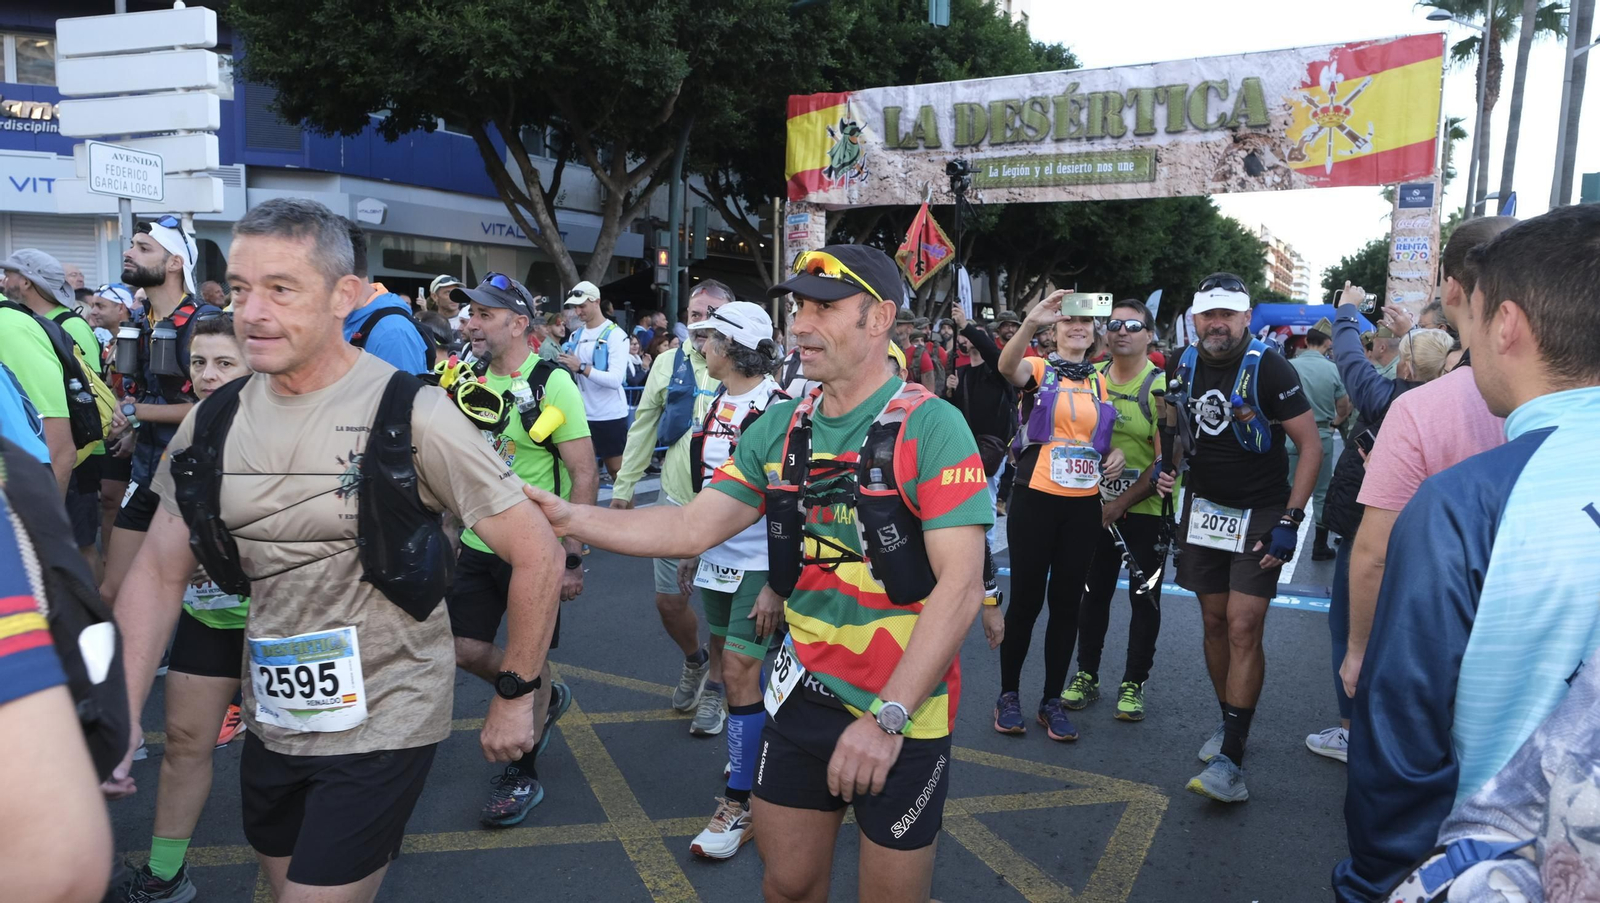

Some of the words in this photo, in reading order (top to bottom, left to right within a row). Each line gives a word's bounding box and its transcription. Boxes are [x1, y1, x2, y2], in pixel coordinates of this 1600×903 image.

[883, 104, 942, 150] LA
[953, 77, 1271, 148] DESÉRTICA
[111, 152, 159, 168] AVENIDA
[105, 163, 148, 181] FEDERICO
[988, 165, 999, 178] La
[1002, 164, 1030, 179] Legión
[1034, 166, 1041, 178] y
[1044, 164, 1053, 175] el
[1056, 161, 1093, 175] desierto
[1097, 163, 1113, 173] nos
[1117, 161, 1135, 172] une
[130, 182, 159, 196] LORCA
[1065, 459, 1095, 475] 3506
[1200, 513, 1238, 534] 2078
[259, 661, 340, 699] 2595
[306, 697, 341, 706] REINALDO
[757, 740, 769, 786] SALOMON
[890, 754, 947, 839] SALOMON
